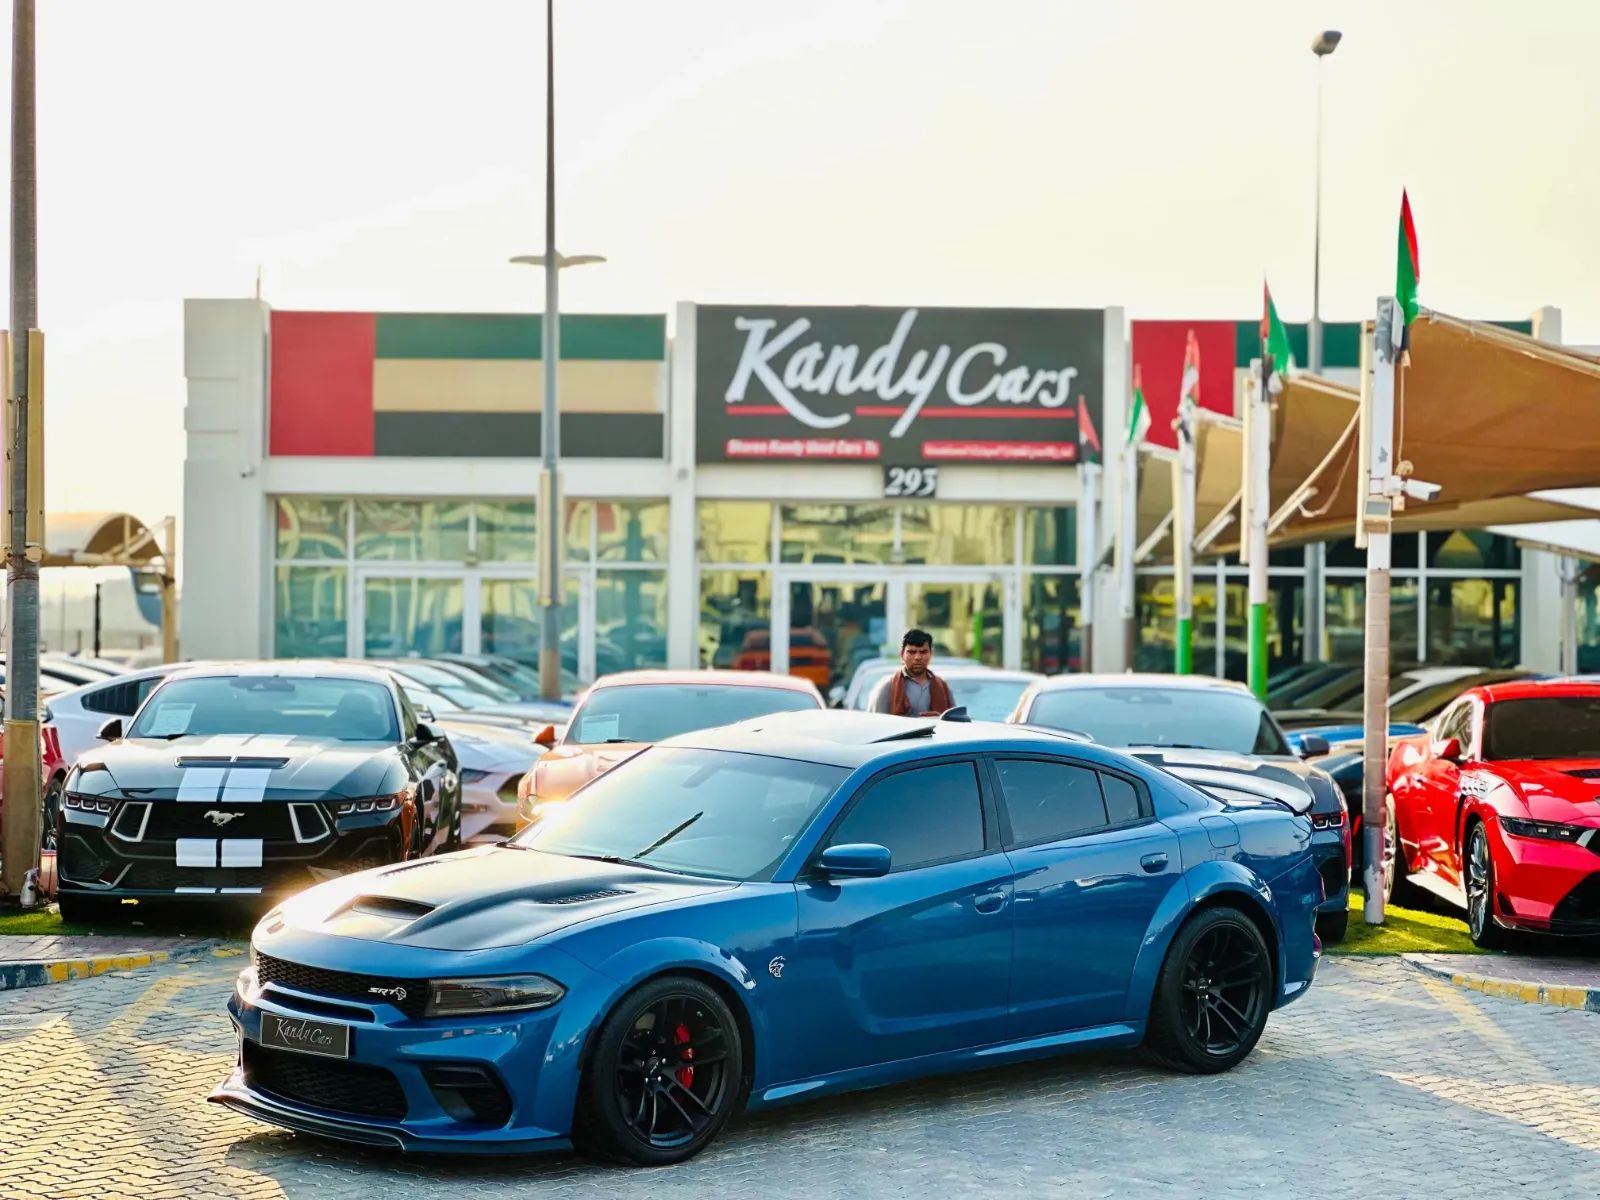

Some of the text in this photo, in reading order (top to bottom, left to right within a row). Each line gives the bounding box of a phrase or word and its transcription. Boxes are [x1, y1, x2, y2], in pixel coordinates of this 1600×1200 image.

[725, 308, 1078, 437] Kandy Cars
[884, 466, 938, 496] 295
[368, 987, 397, 996] SRT
[275, 1018, 333, 1045] Kandy Cars
